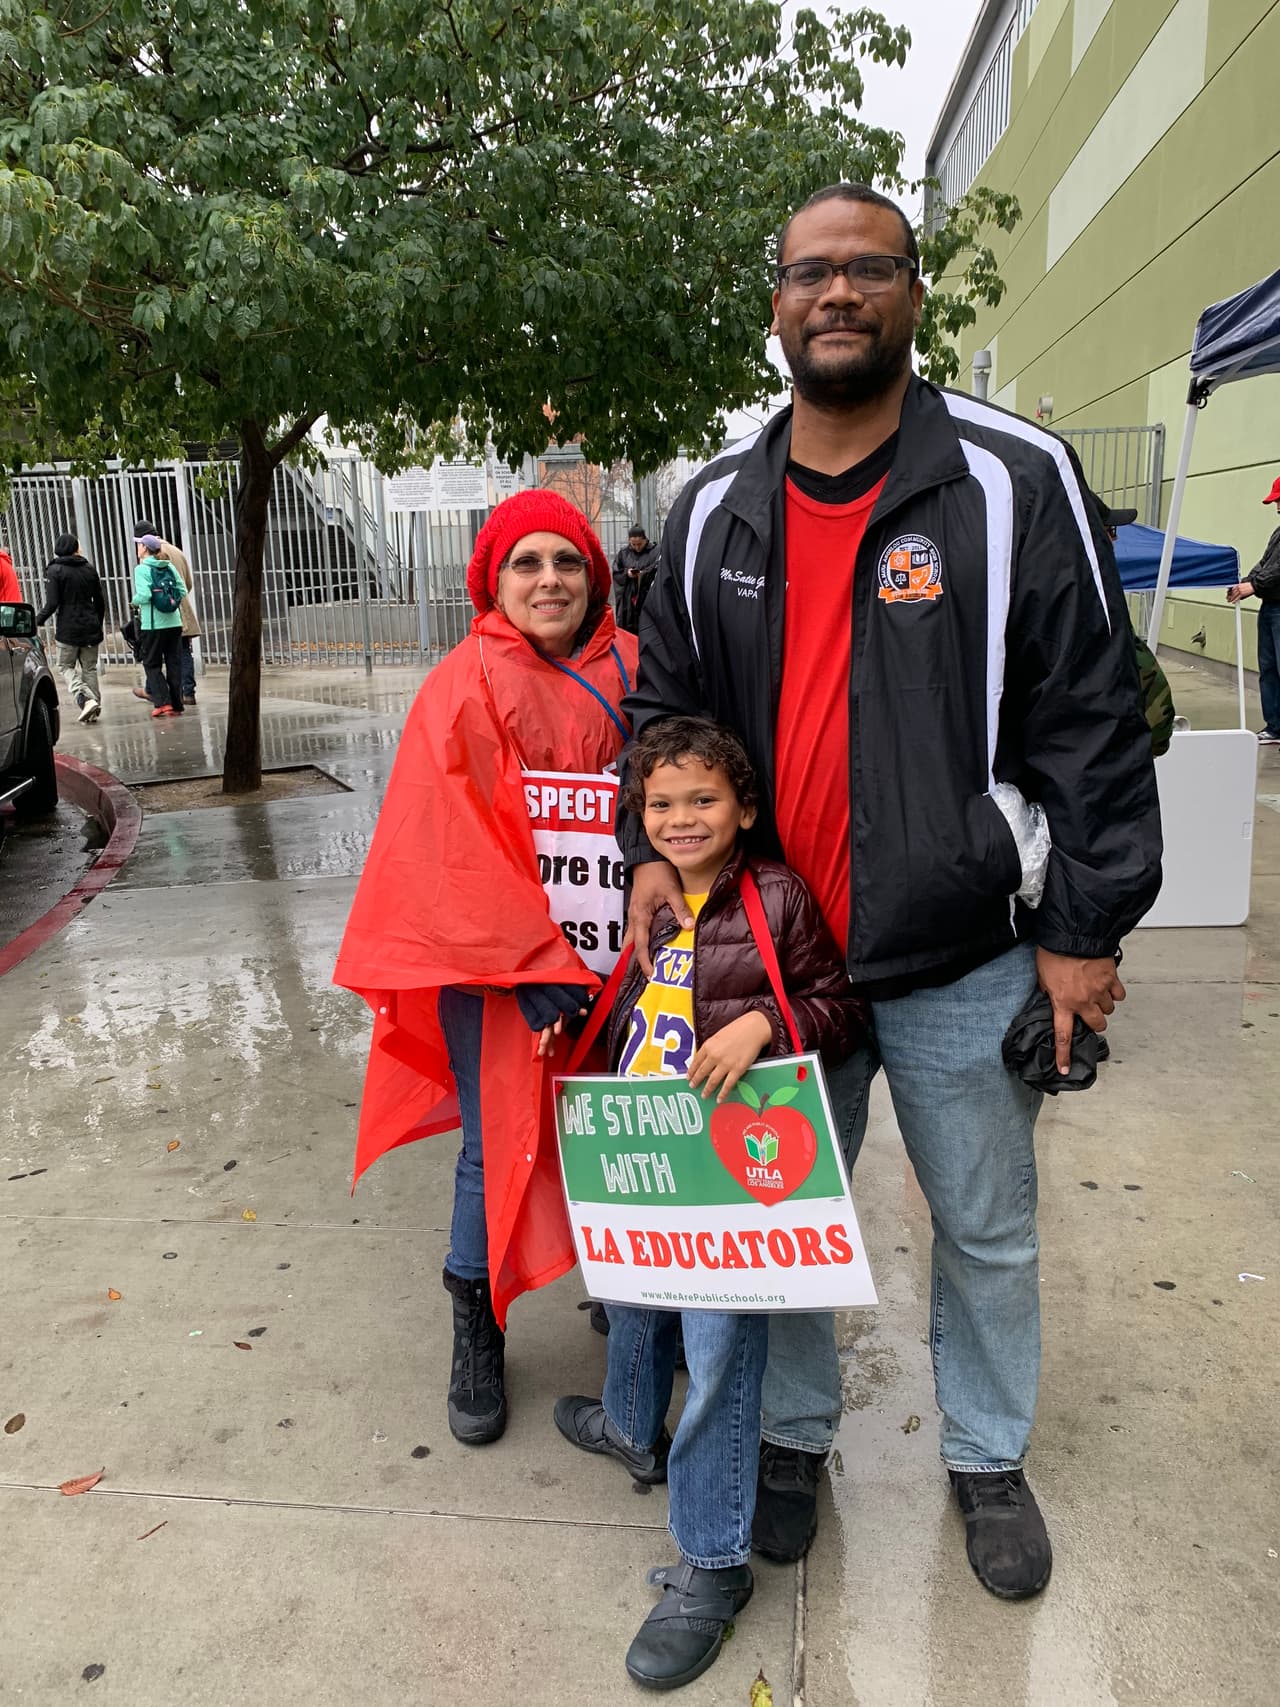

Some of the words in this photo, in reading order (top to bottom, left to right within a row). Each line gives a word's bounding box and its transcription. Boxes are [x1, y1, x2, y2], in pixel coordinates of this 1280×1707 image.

[900, 536, 931, 548] COMMUNITY
[737, 587, 758, 600] VAPA
[561, 1093, 597, 1136] WE
[601, 1092, 704, 1136] STAND
[600, 1152, 677, 1194] WITH
[745, 1166, 783, 1181] UTLA
[581, 1226, 625, 1265] LA
[626, 1224, 854, 1270] EDUCATORS
[641, 1291, 786, 1304] www.WeArePublicSchools.org
